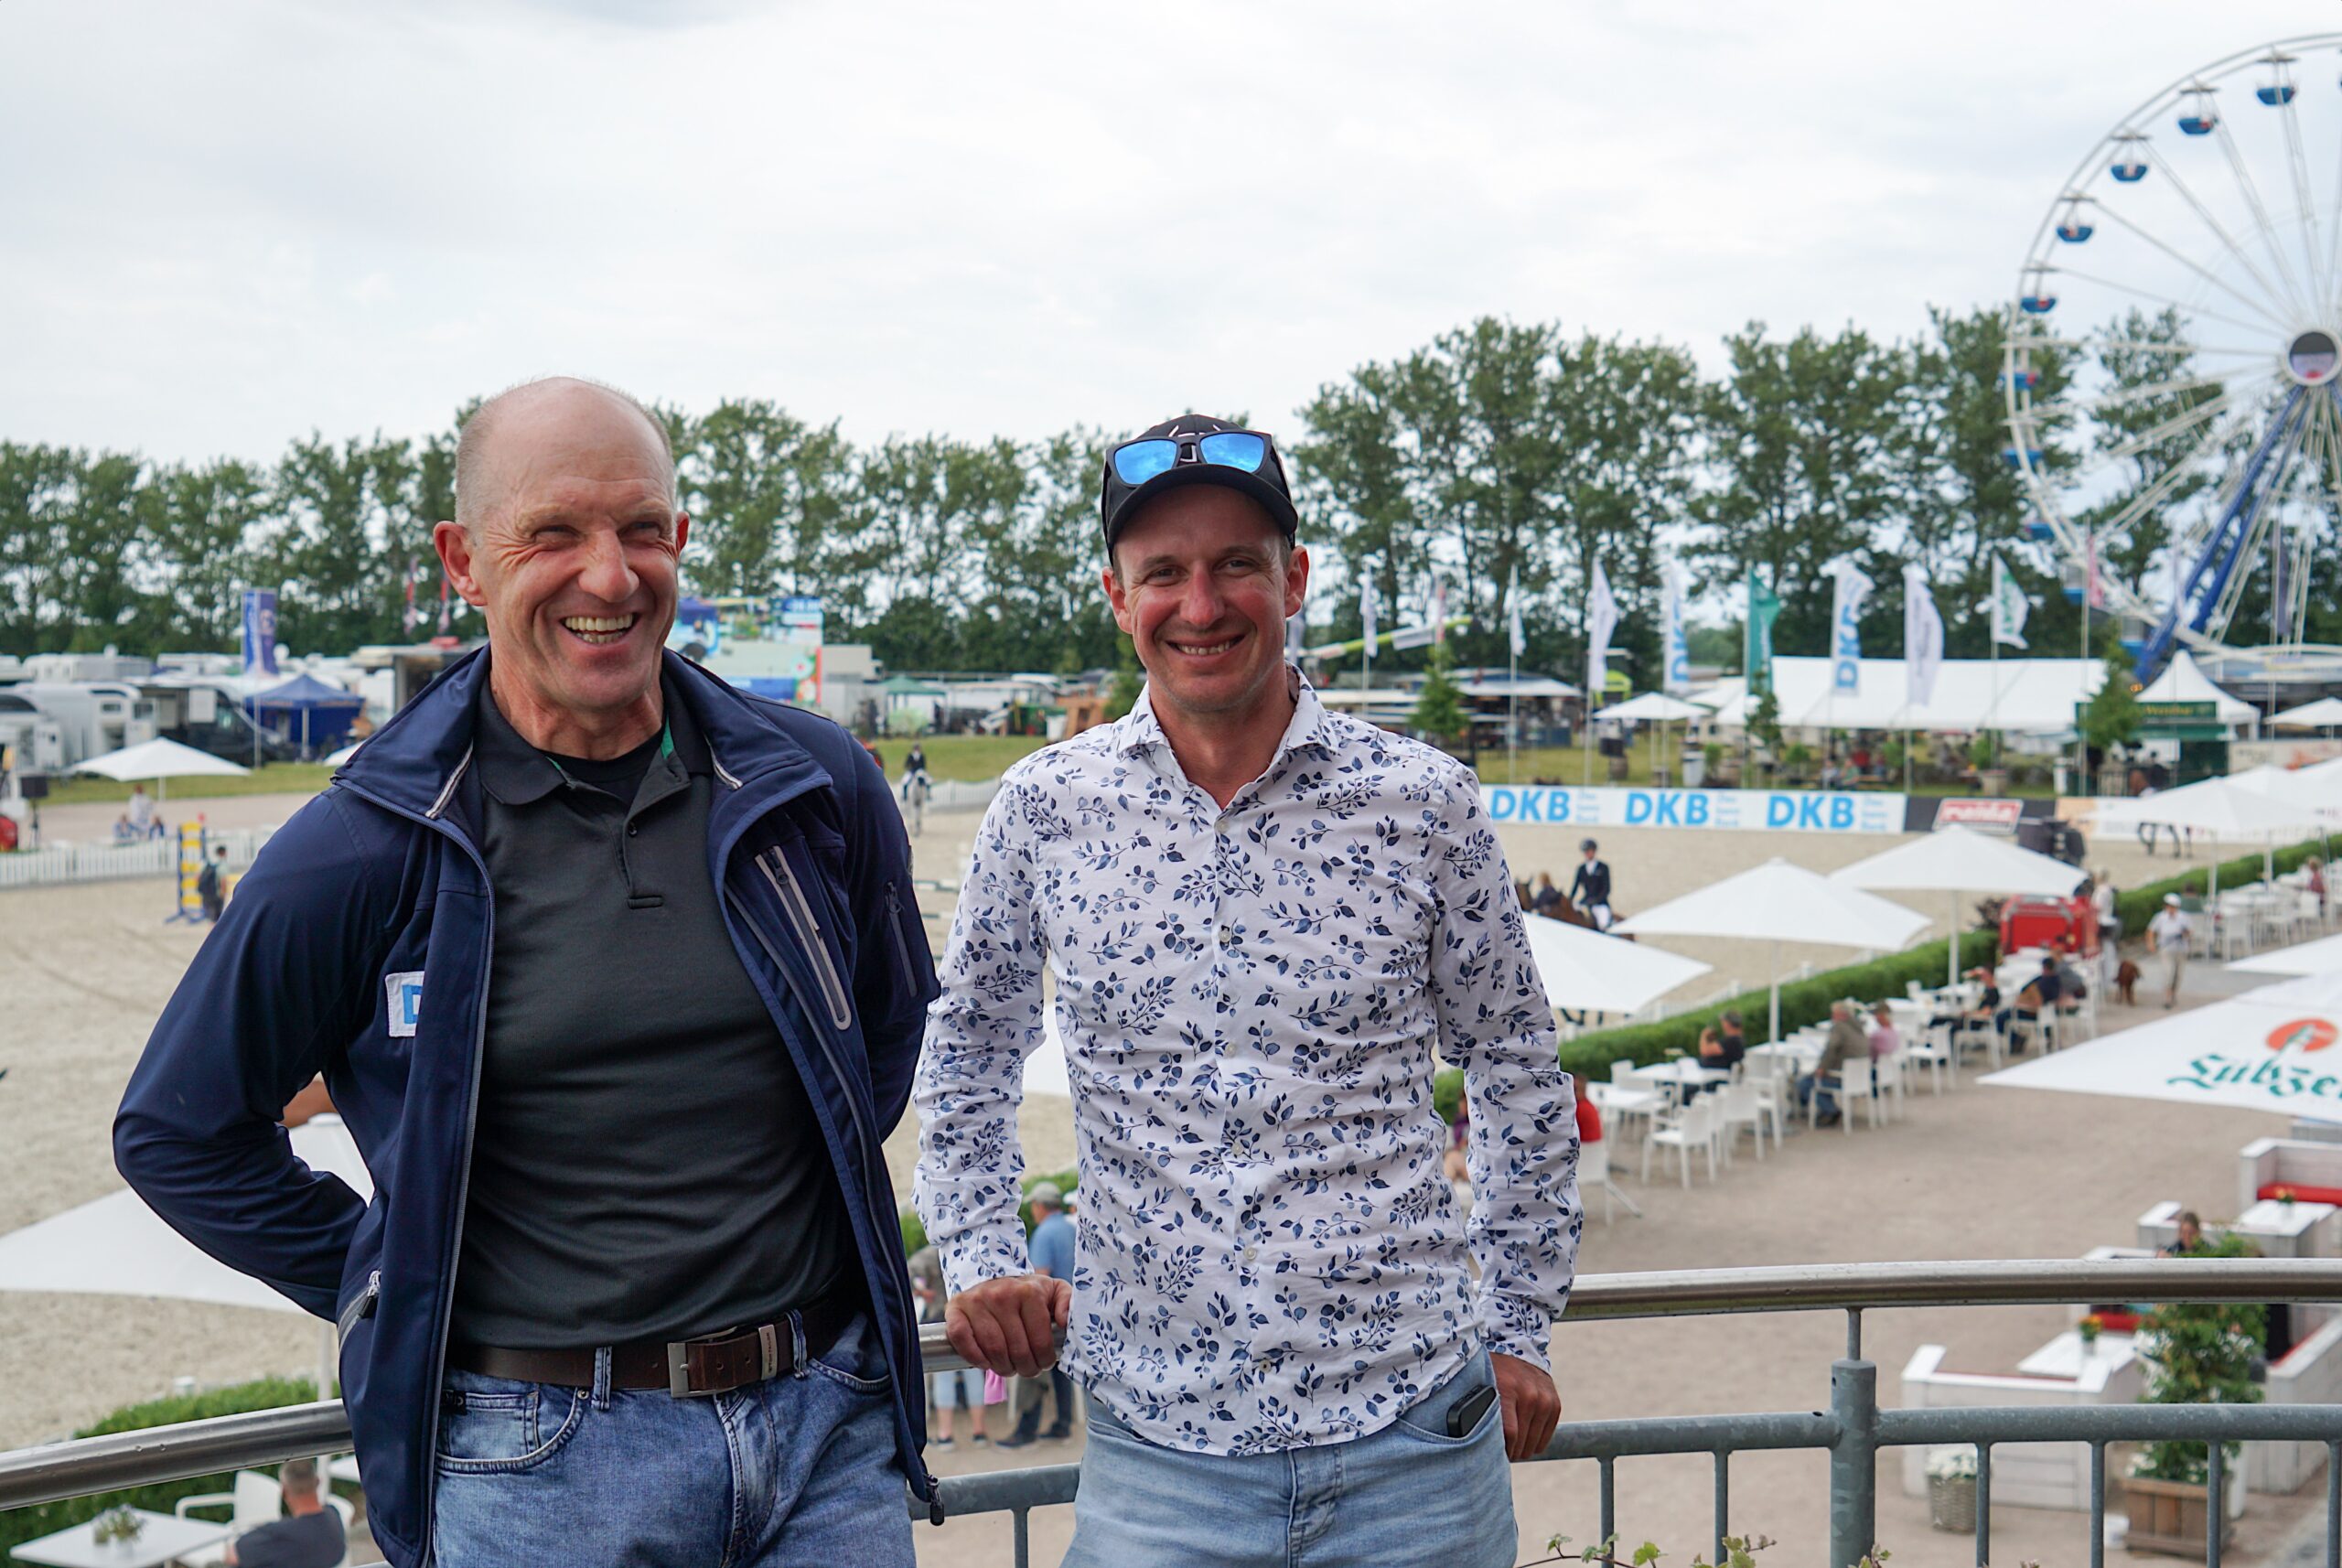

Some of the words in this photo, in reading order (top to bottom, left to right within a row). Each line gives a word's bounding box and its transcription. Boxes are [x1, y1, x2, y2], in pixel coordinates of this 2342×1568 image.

[1489, 789, 1571, 822] DKB
[1624, 792, 1709, 825] DKB
[1766, 795, 1854, 829] DKB
